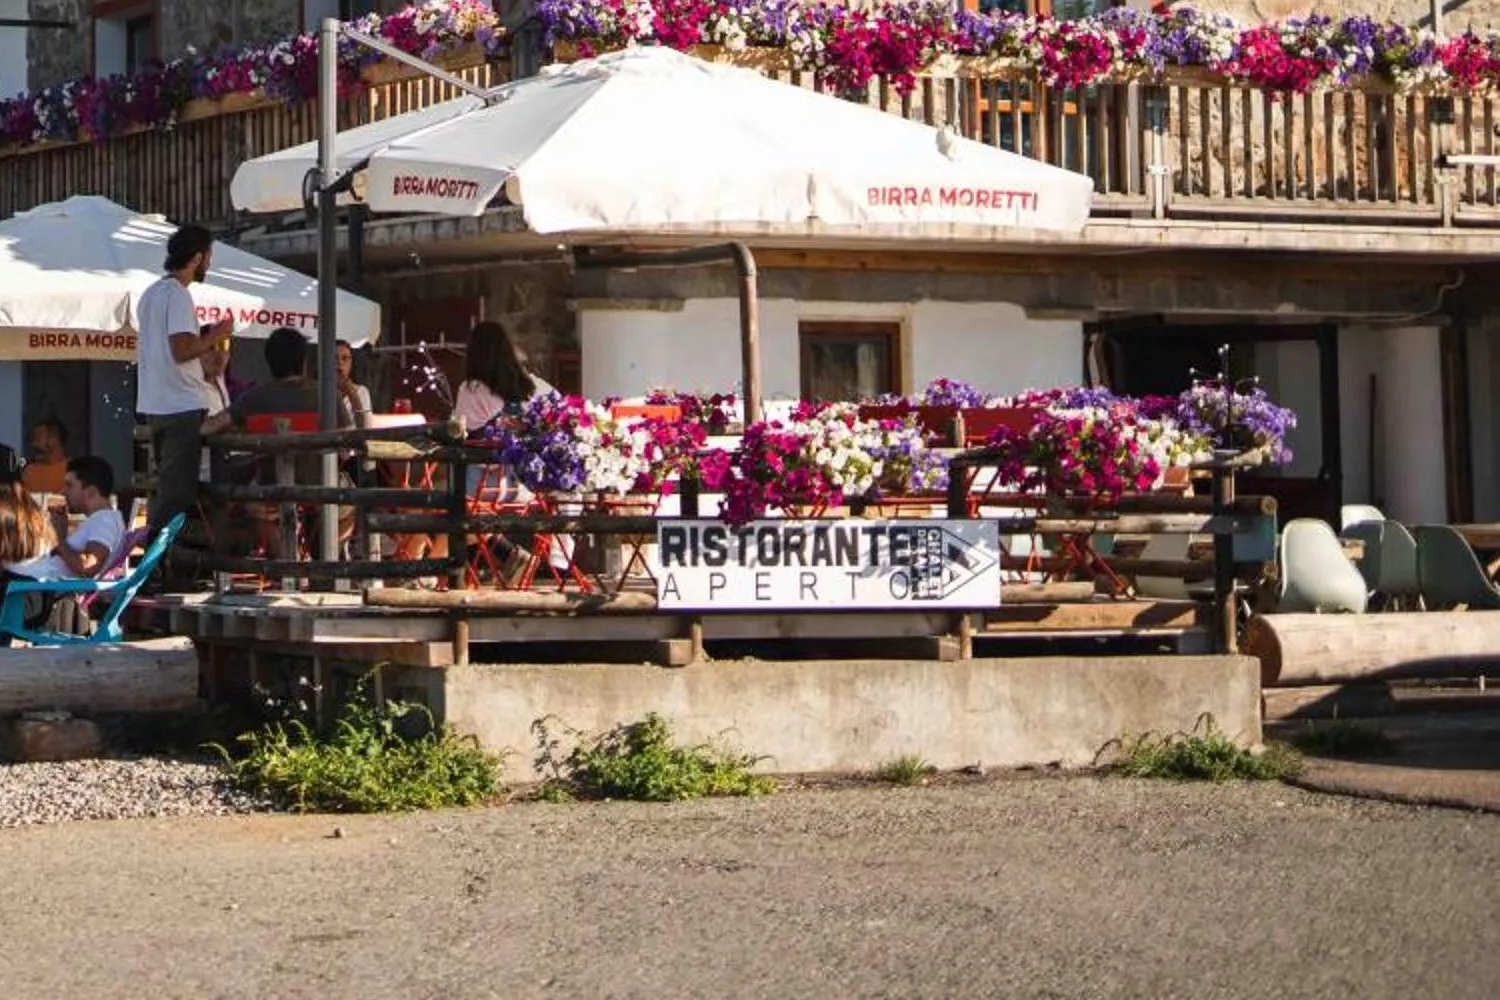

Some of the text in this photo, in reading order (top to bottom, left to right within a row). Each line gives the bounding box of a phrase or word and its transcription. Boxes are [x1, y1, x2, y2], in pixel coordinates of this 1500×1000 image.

[868, 187, 1038, 211] BIRRA MORETTI
[194, 306, 320, 328] RRA MORETT
[29, 333, 137, 350] BIRRA MORE
[661, 526, 911, 568] RISTORANTE
[662, 571, 909, 600] APERTO
